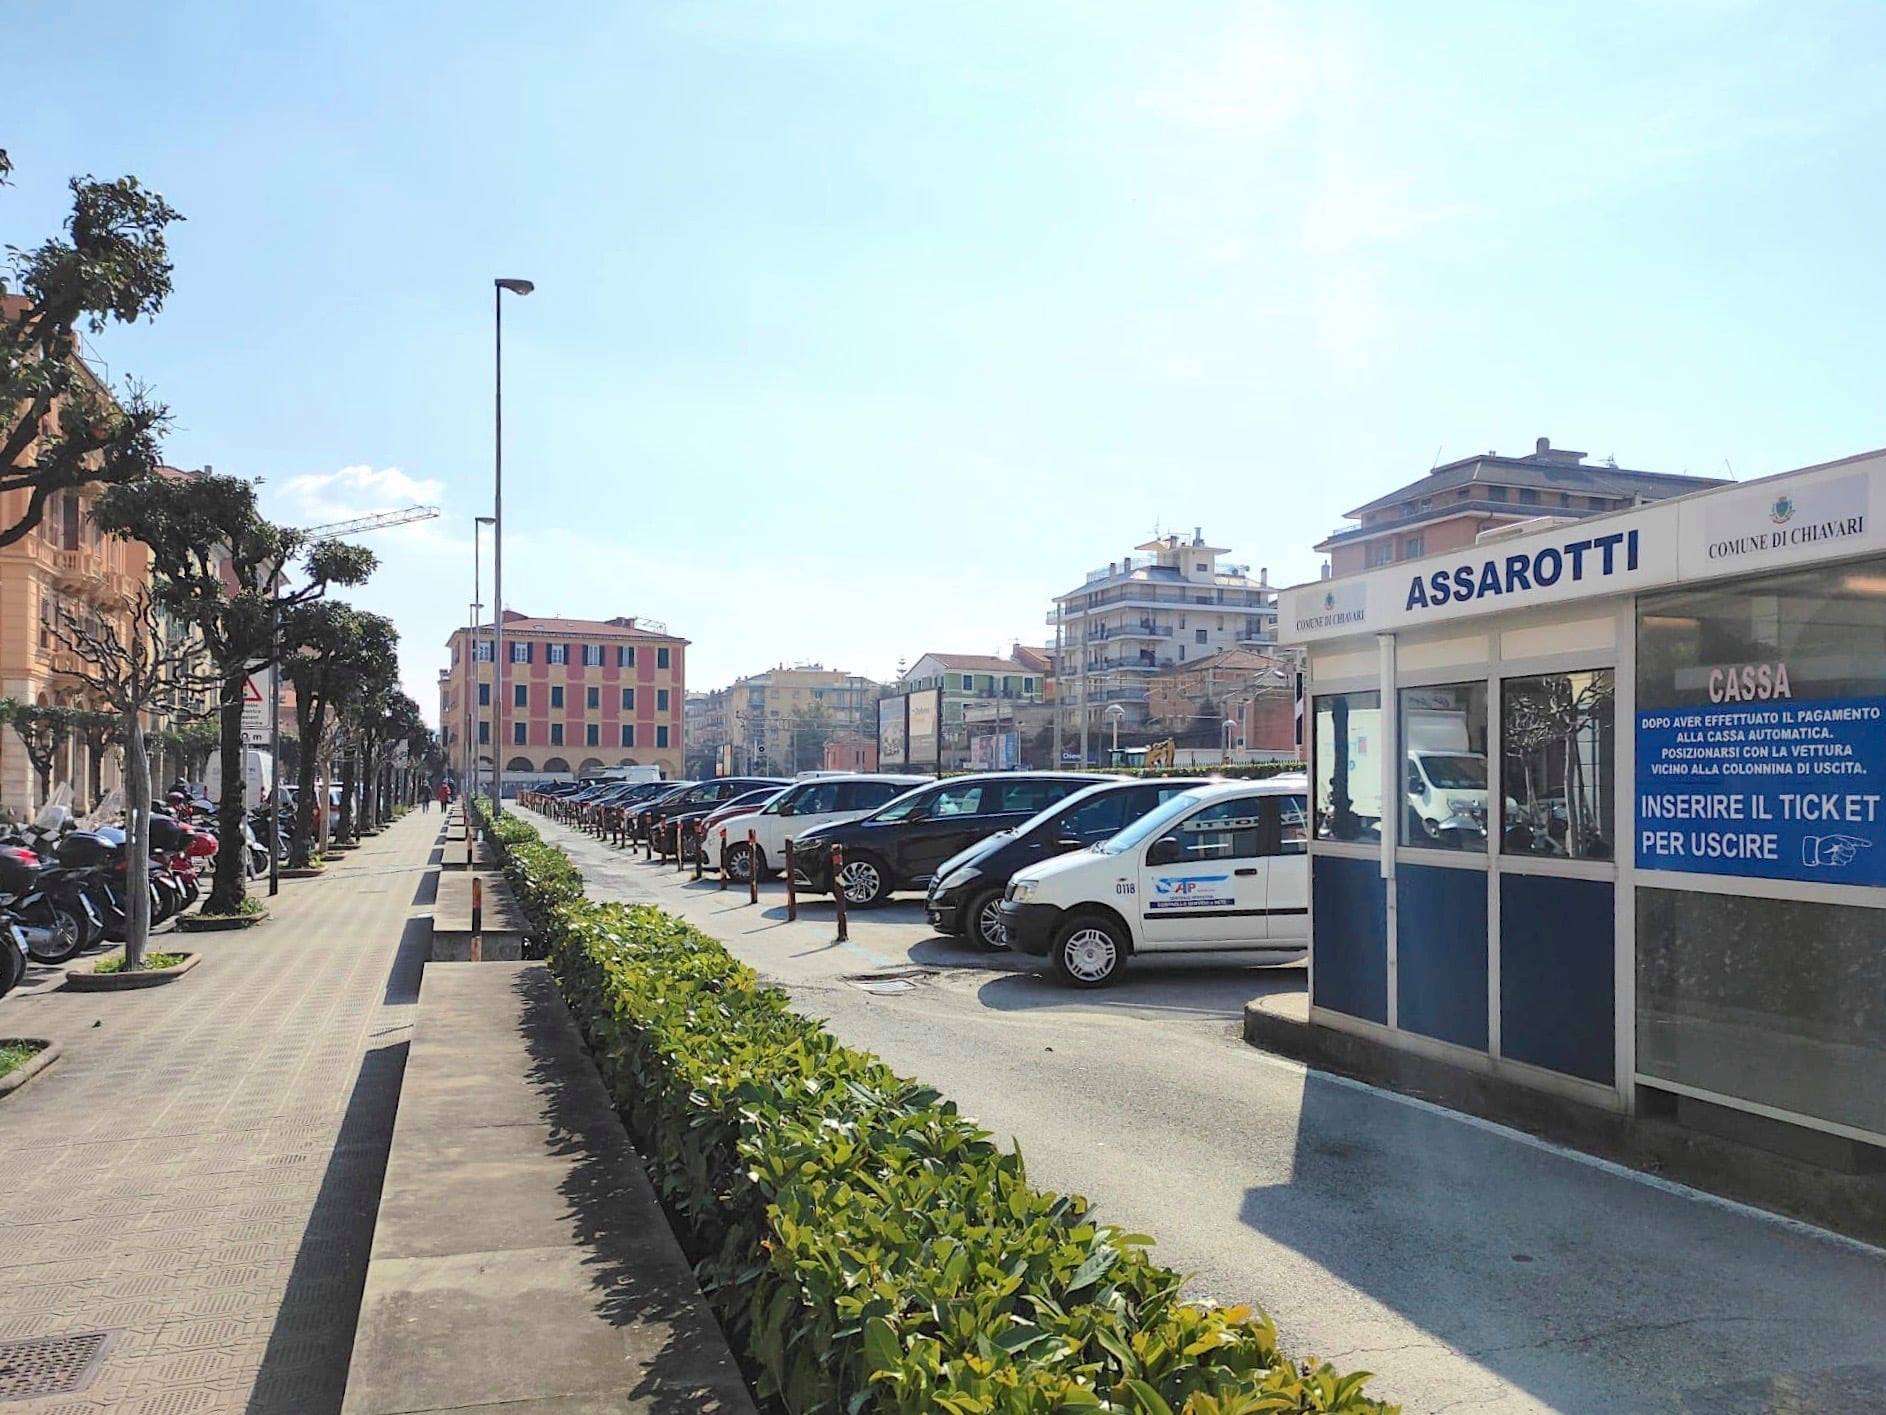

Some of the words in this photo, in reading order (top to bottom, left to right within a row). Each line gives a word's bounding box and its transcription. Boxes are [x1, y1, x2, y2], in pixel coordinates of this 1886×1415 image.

[1709, 534, 1768, 559] COMUNE
[1772, 530, 1787, 548] DI
[1791, 516, 1864, 544] CHIAVARI
[1406, 529, 1639, 611] ASSAROTTI
[1296, 616, 1323, 632] COMUNE
[1324, 614, 1332, 627] DI
[1333, 609, 1365, 625] CHIAVARI
[1709, 663, 1792, 703] CASSA
[1642, 718, 1671, 729] DOPO
[1673, 716, 1702, 727] AVER
[1704, 712, 1779, 726] EFFETTUATO
[1782, 712, 1794, 723] IL
[1798, 707, 1880, 722] PAGAMENTO
[1676, 732, 1705, 743] ALLA
[1707, 730, 1745, 742] CASSA
[1748, 727, 1834, 741] AUTOMATICA.
[1661, 748, 1740, 759] POSIZIONARSI
[1743, 746, 1768, 757] CON
[1771, 746, 1788, 757] LA
[1791, 744, 1853, 757] VETTURA
[1651, 763, 1689, 774] VICINO
[1690, 764, 1719, 774] ALLA
[1722, 763, 1793, 775] COLONNINA
[1797, 762, 1810, 774] DI
[1814, 761, 1867, 774] USCITA.
[1641, 794, 1744, 819] INSERIRE
[1751, 794, 1773, 819] IL
[1779, 794, 1880, 822] TICKET
[1642, 831, 1685, 855] PER
[1691, 833, 1779, 860] USCIRE
[1116, 884, 1136, 894] 0118
